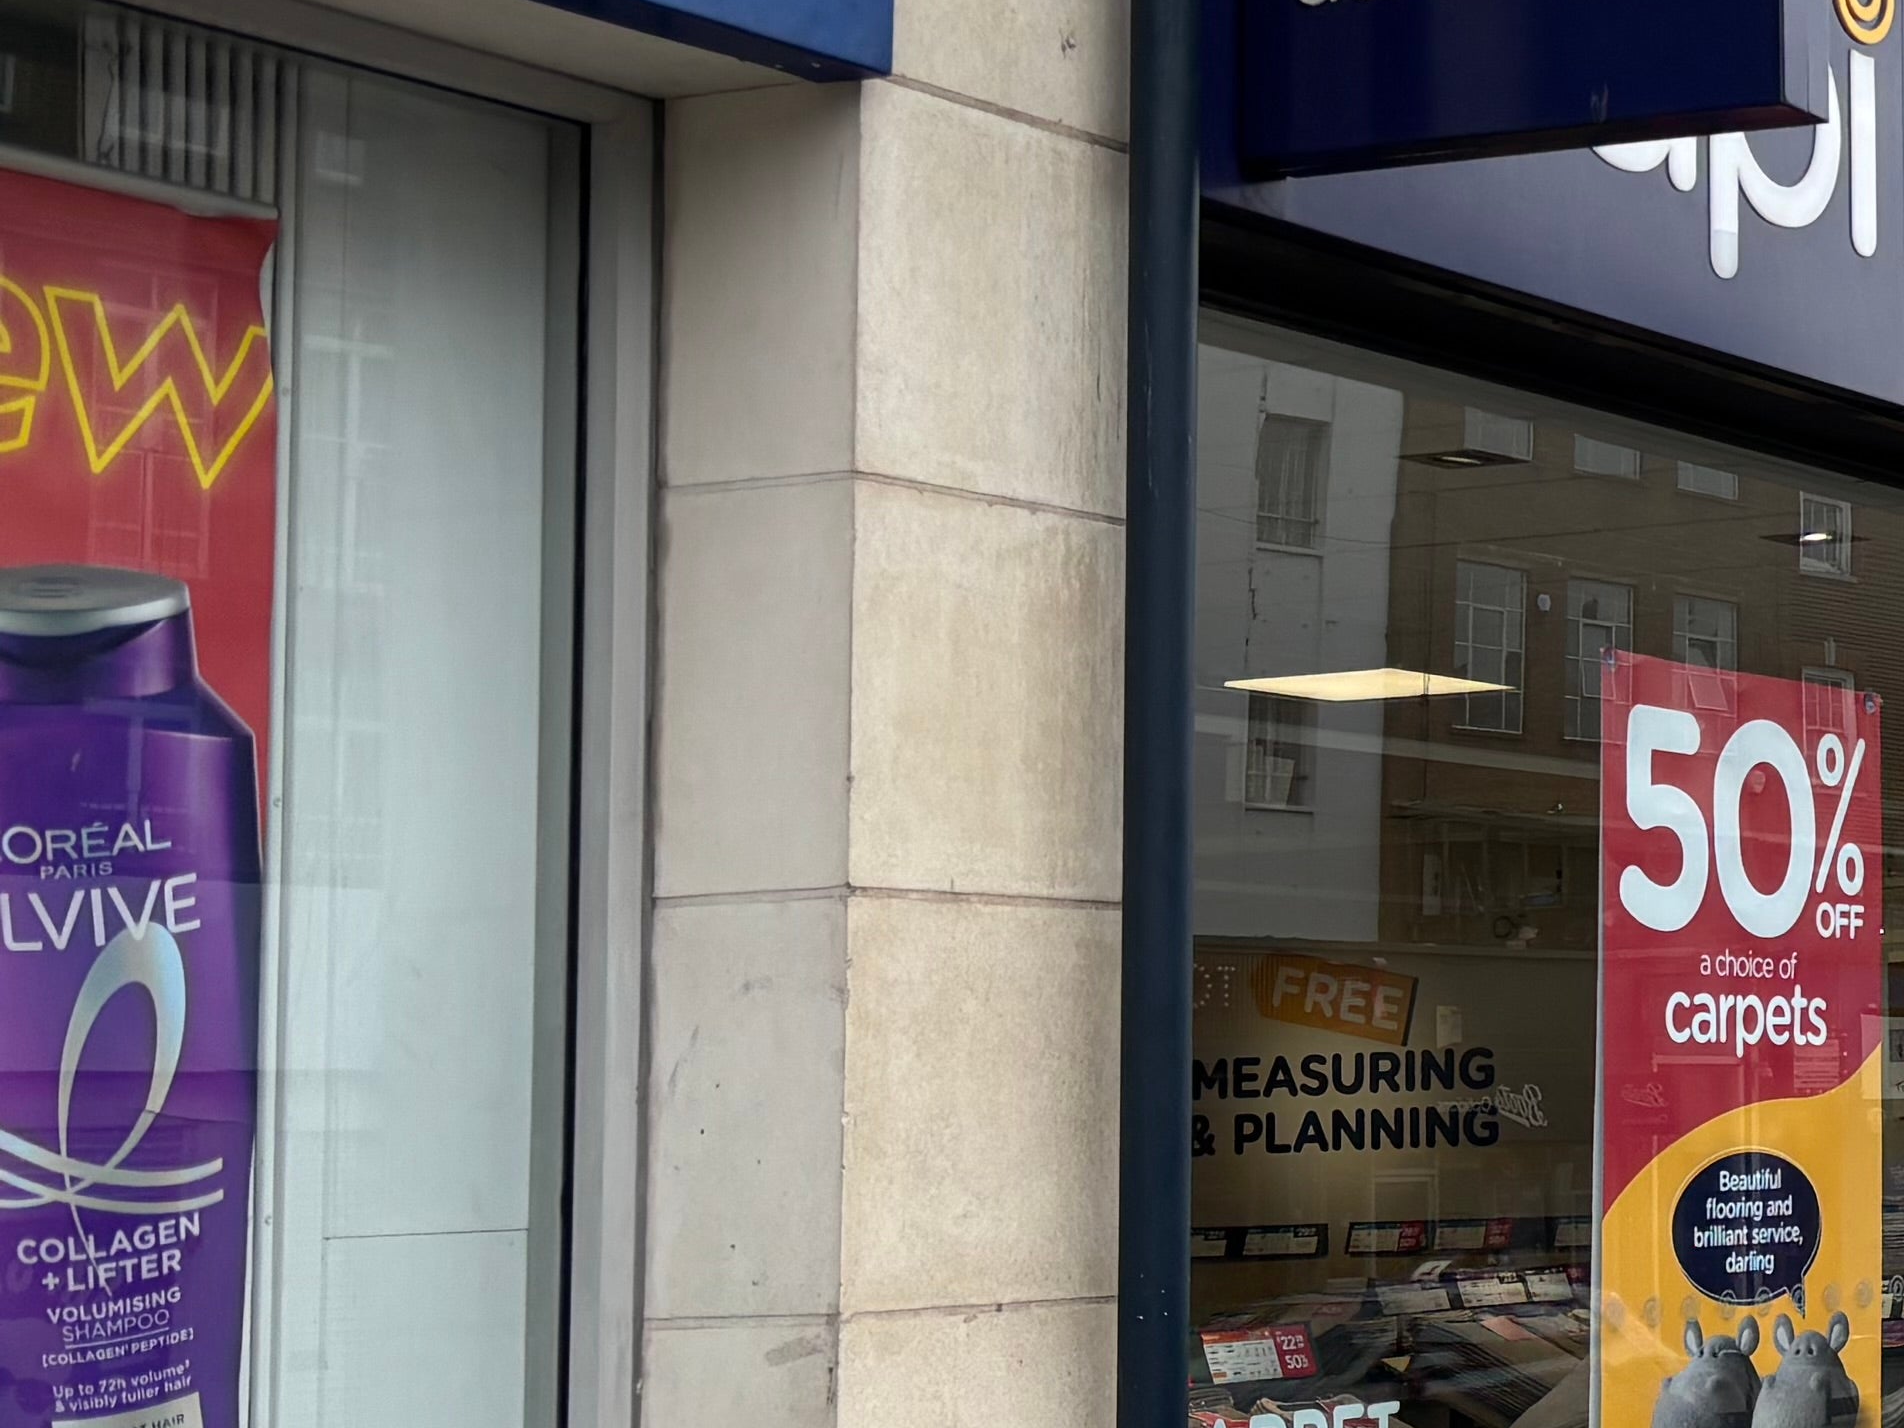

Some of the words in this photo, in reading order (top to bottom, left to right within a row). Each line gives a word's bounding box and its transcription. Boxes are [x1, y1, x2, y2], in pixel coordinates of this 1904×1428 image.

[1619, 703, 1866, 939] 50%
[0, 820, 171, 864] ORÉAL
[40, 861, 113, 879] PARIS
[0, 872, 200, 952] LVIVE
[1816, 903, 1864, 940] OFF
[1700, 954, 1711, 976] a
[1715, 949, 1774, 979] choice
[1779, 951, 1798, 979] of
[1273, 966, 1404, 1031] FREE
[1665, 984, 1828, 1058] carpets
[1192, 1046, 1495, 1099] MEASURING
[1233, 1104, 1499, 1155] PLANNING
[1719, 1168, 1782, 1191] Beautiful
[1706, 1197, 1764, 1222] flooring
[1767, 1195, 1793, 1217] and
[17, 1212, 200, 1264] COLLAGEN
[1694, 1226, 1747, 1248] brilliant
[1751, 1226, 1803, 1247] service,
[68, 1249, 182, 1292] LIFTER
[1725, 1252, 1775, 1275] darling
[47, 1286, 181, 1324] VOLUMISING
[63, 1309, 170, 1342] SHAMPOO
[53, 1385, 73, 1401] Up
[78, 1382, 94, 1396] to
[99, 1378, 126, 1393] 72h
[69, 1392, 117, 1413] visibly
[122, 1385, 160, 1404] fuller
[164, 1375, 192, 1393] hair
